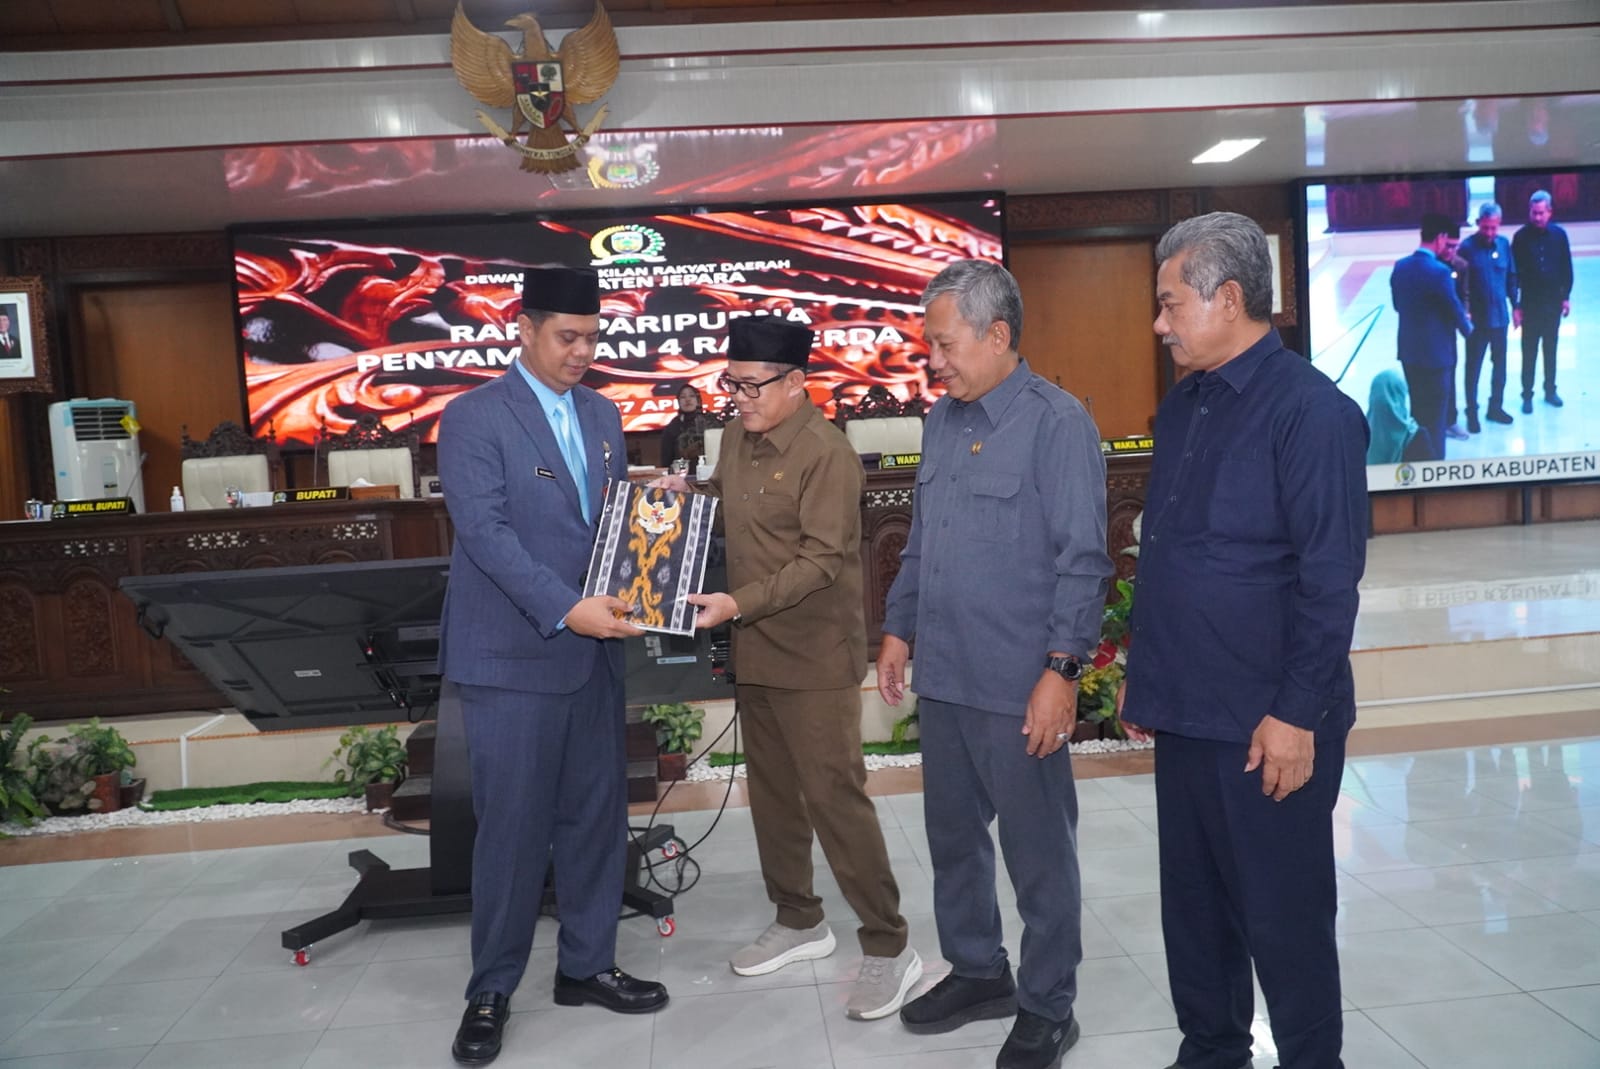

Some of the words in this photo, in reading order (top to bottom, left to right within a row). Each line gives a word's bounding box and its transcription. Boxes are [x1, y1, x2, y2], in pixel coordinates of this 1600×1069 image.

[653, 263, 716, 275] RAKYAT
[721, 260, 791, 272] DAERAH
[660, 273, 746, 287] JEPARA
[450, 323, 521, 343] RAP
[599, 307, 812, 335] ARIPUA
[357, 340, 646, 372] PENYAMAN
[658, 338, 682, 355] 4
[1422, 464, 1475, 482] DPRD
[1482, 456, 1596, 478] KABUPATEN
[296, 490, 336, 500] BUPATI
[68, 503, 94, 512] WAKIL
[96, 501, 125, 511] BUPATI
